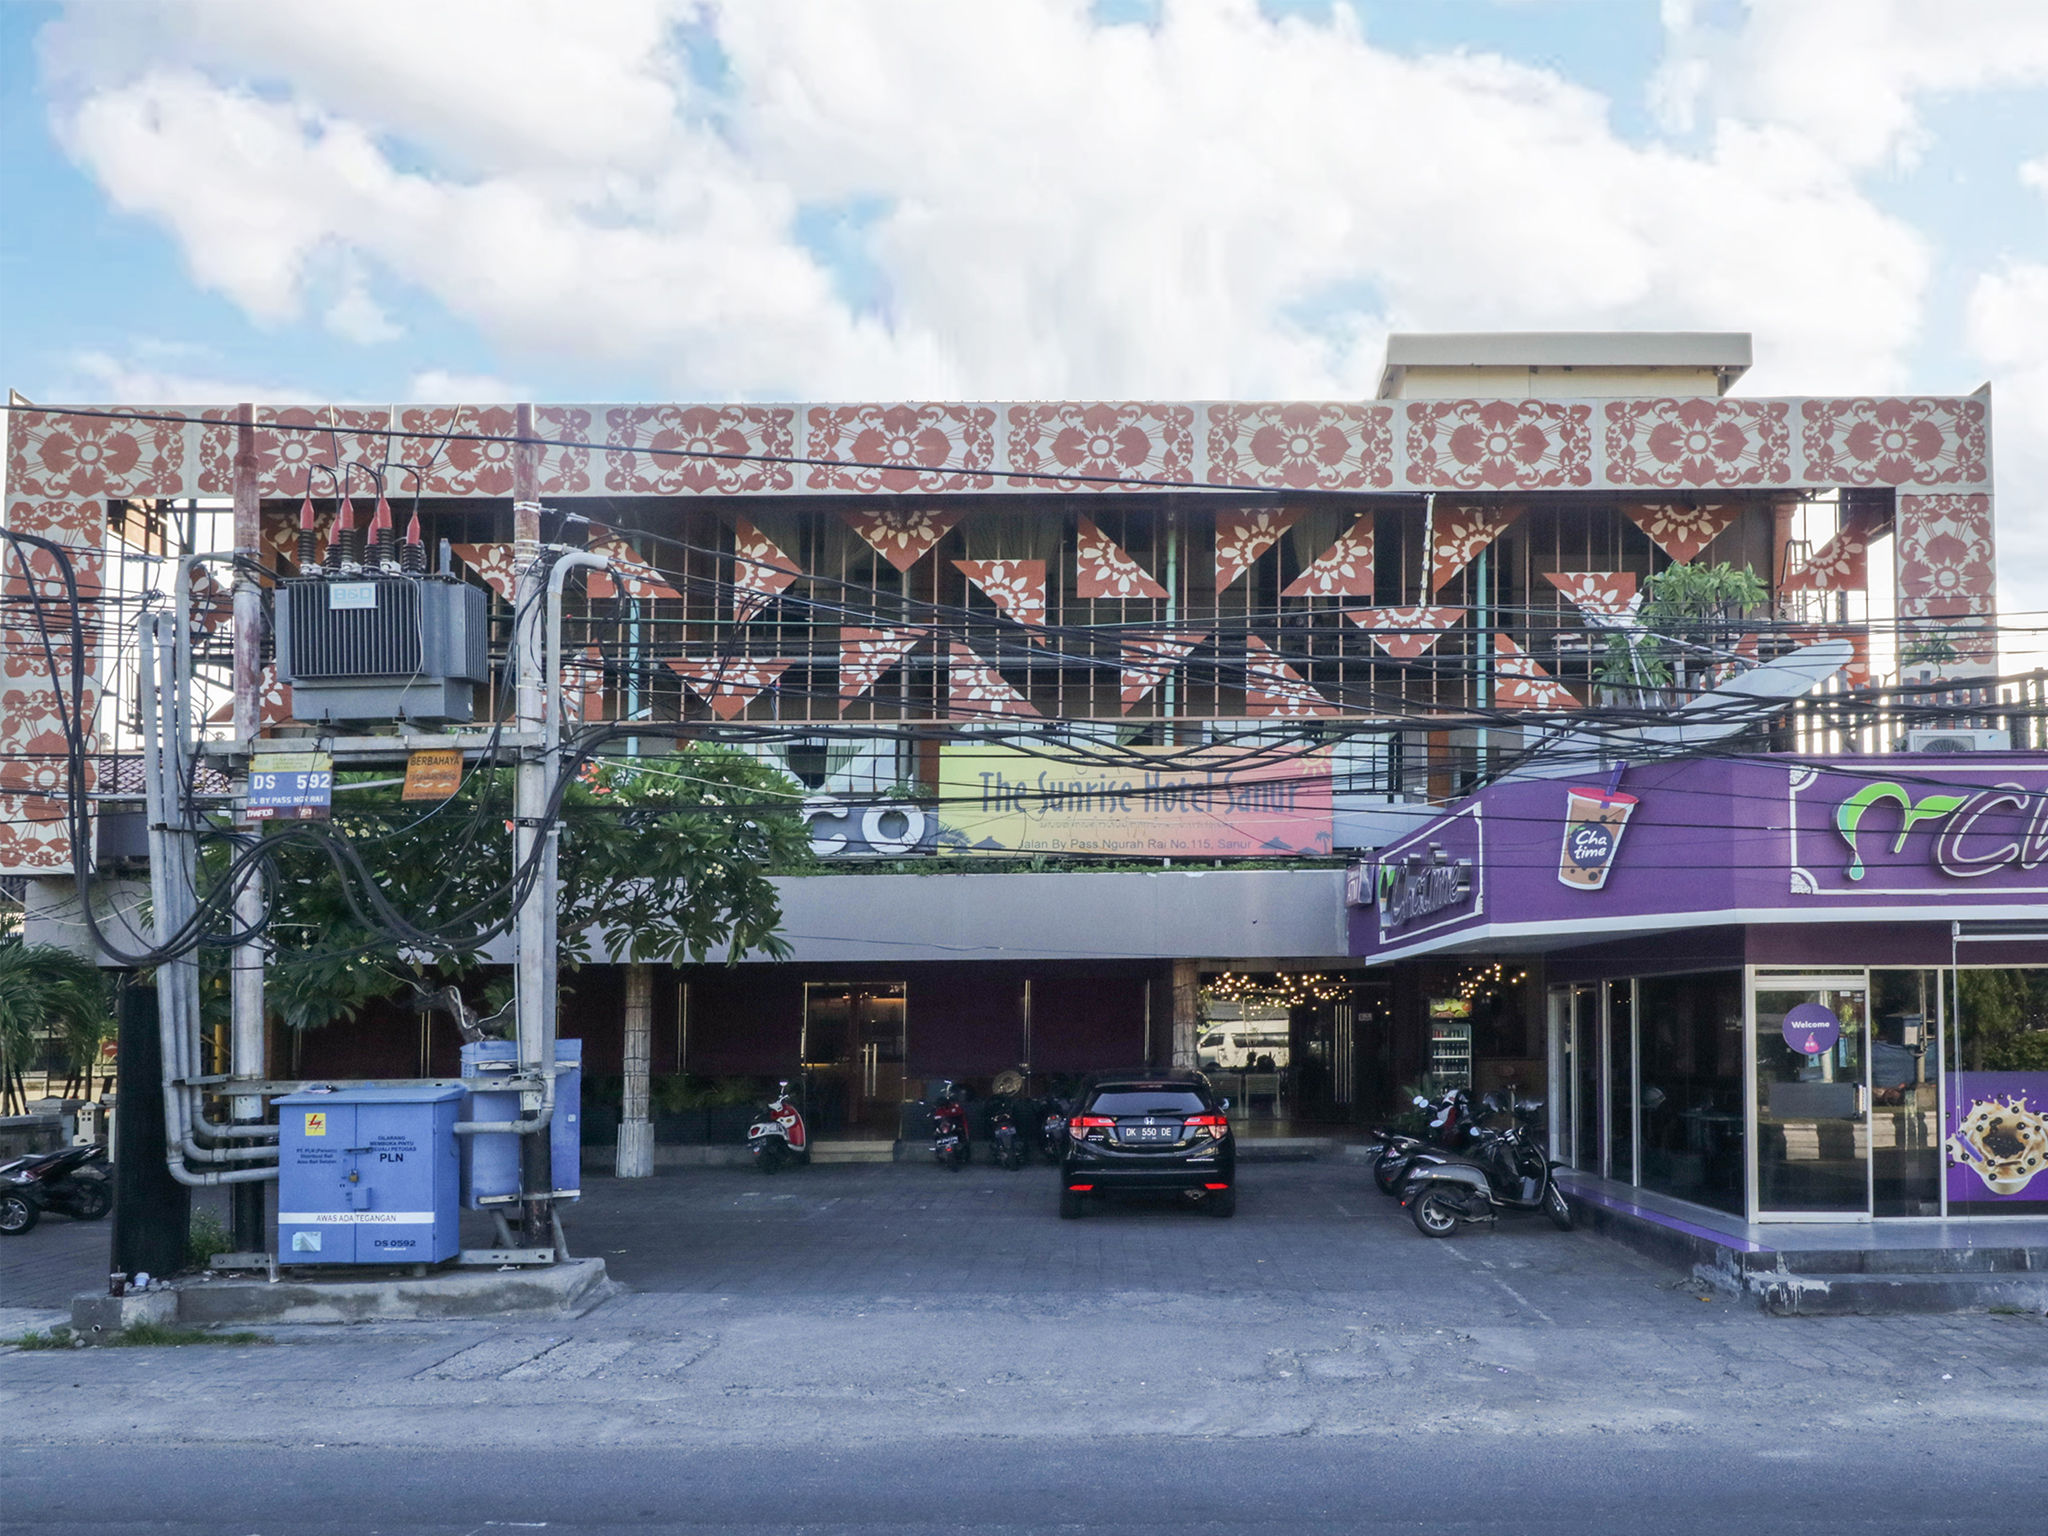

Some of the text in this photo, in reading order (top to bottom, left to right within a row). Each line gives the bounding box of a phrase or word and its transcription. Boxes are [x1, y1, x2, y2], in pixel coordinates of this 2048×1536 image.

[410, 755, 460, 766] BERBAHAYA
[253, 773, 330, 790] DS 592
[979, 770, 1301, 815] The Sunrise Hotel Sanur
[271, 796, 292, 804] PASS
[1575, 830, 1607, 845] Cha
[1018, 839, 1048, 850] Jalan
[1052, 839, 1067, 853] By
[1070, 839, 1098, 849] Pass
[1102, 839, 1144, 853] Ngurah
[1147, 839, 1167, 850] Rai
[1218, 839, 1252, 850] Sanur
[1574, 845, 1607, 859] time
[1791, 1021, 1830, 1029] Welcome
[1126, 1127, 1172, 1136] DK 550 DE
[379, 1153, 404, 1162] PLN
[316, 1214, 397, 1222] AWAS ADA TEGANGAN
[374, 1239, 417, 1247] DS 0592
